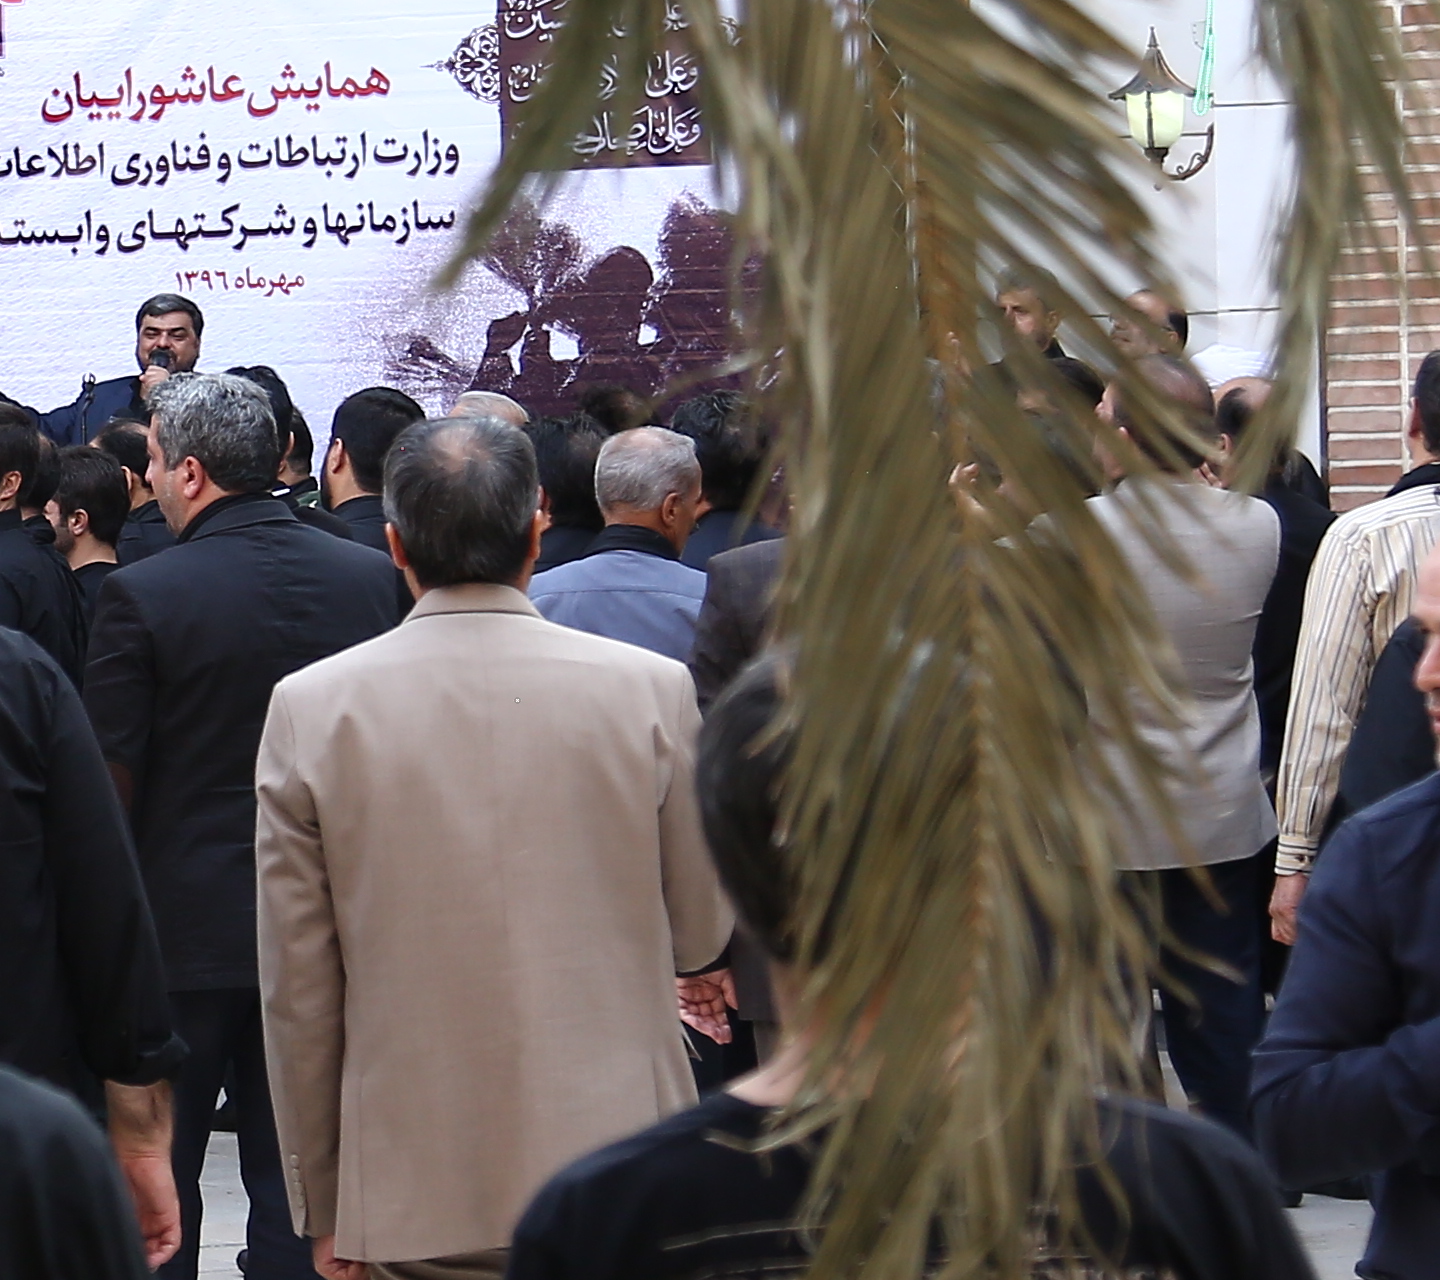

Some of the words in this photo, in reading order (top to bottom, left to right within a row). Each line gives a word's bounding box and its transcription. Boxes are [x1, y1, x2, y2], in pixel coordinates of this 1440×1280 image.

[40, 65, 246, 124] عاشوراییان
[247, 60, 391, 117] همایش
[110, 132, 212, 187] فناوری
[218, 152, 232, 183] و
[237, 131, 367, 179] ارتباطات
[373, 129, 460, 176] وزارت
[115, 202, 297, 254] شرکتهای
[301, 217, 318, 248] و
[322, 199, 456, 245] سازمانها
[234, 266, 305, 298] مهرماه
